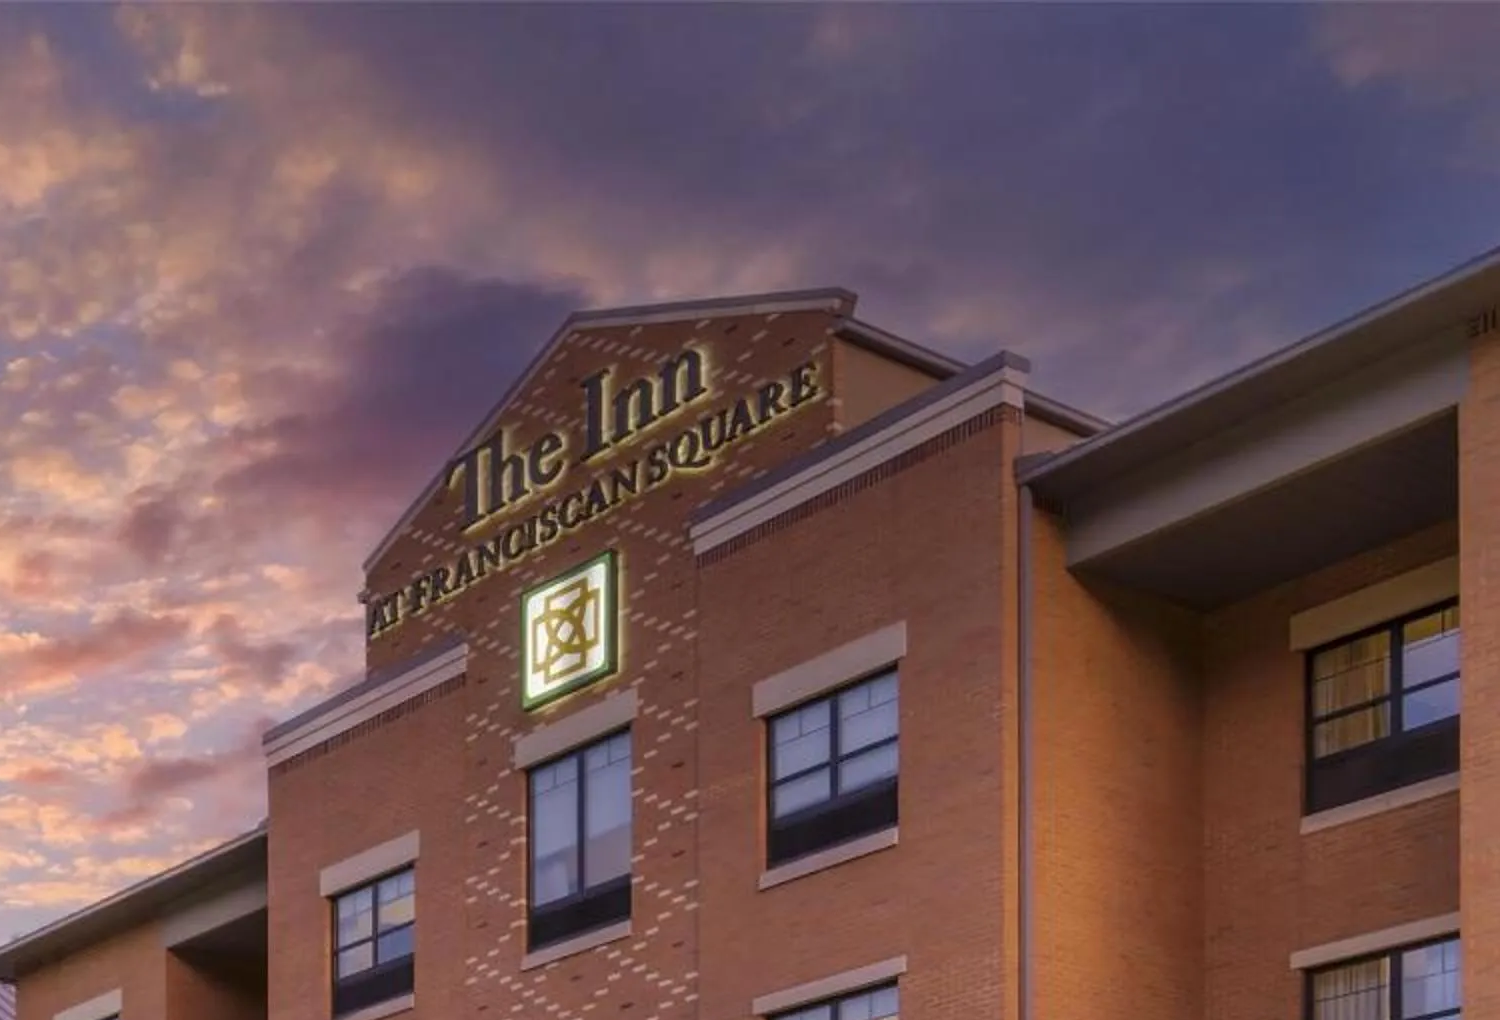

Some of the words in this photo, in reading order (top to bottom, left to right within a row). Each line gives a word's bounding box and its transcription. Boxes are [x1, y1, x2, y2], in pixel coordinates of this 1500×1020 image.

[370, 592, 401, 635] AT
[407, 460, 638, 615] FRANCISCAN
[647, 361, 818, 483] SQUARE
[446, 428, 563, 531] The
[579, 349, 707, 460] Inn
